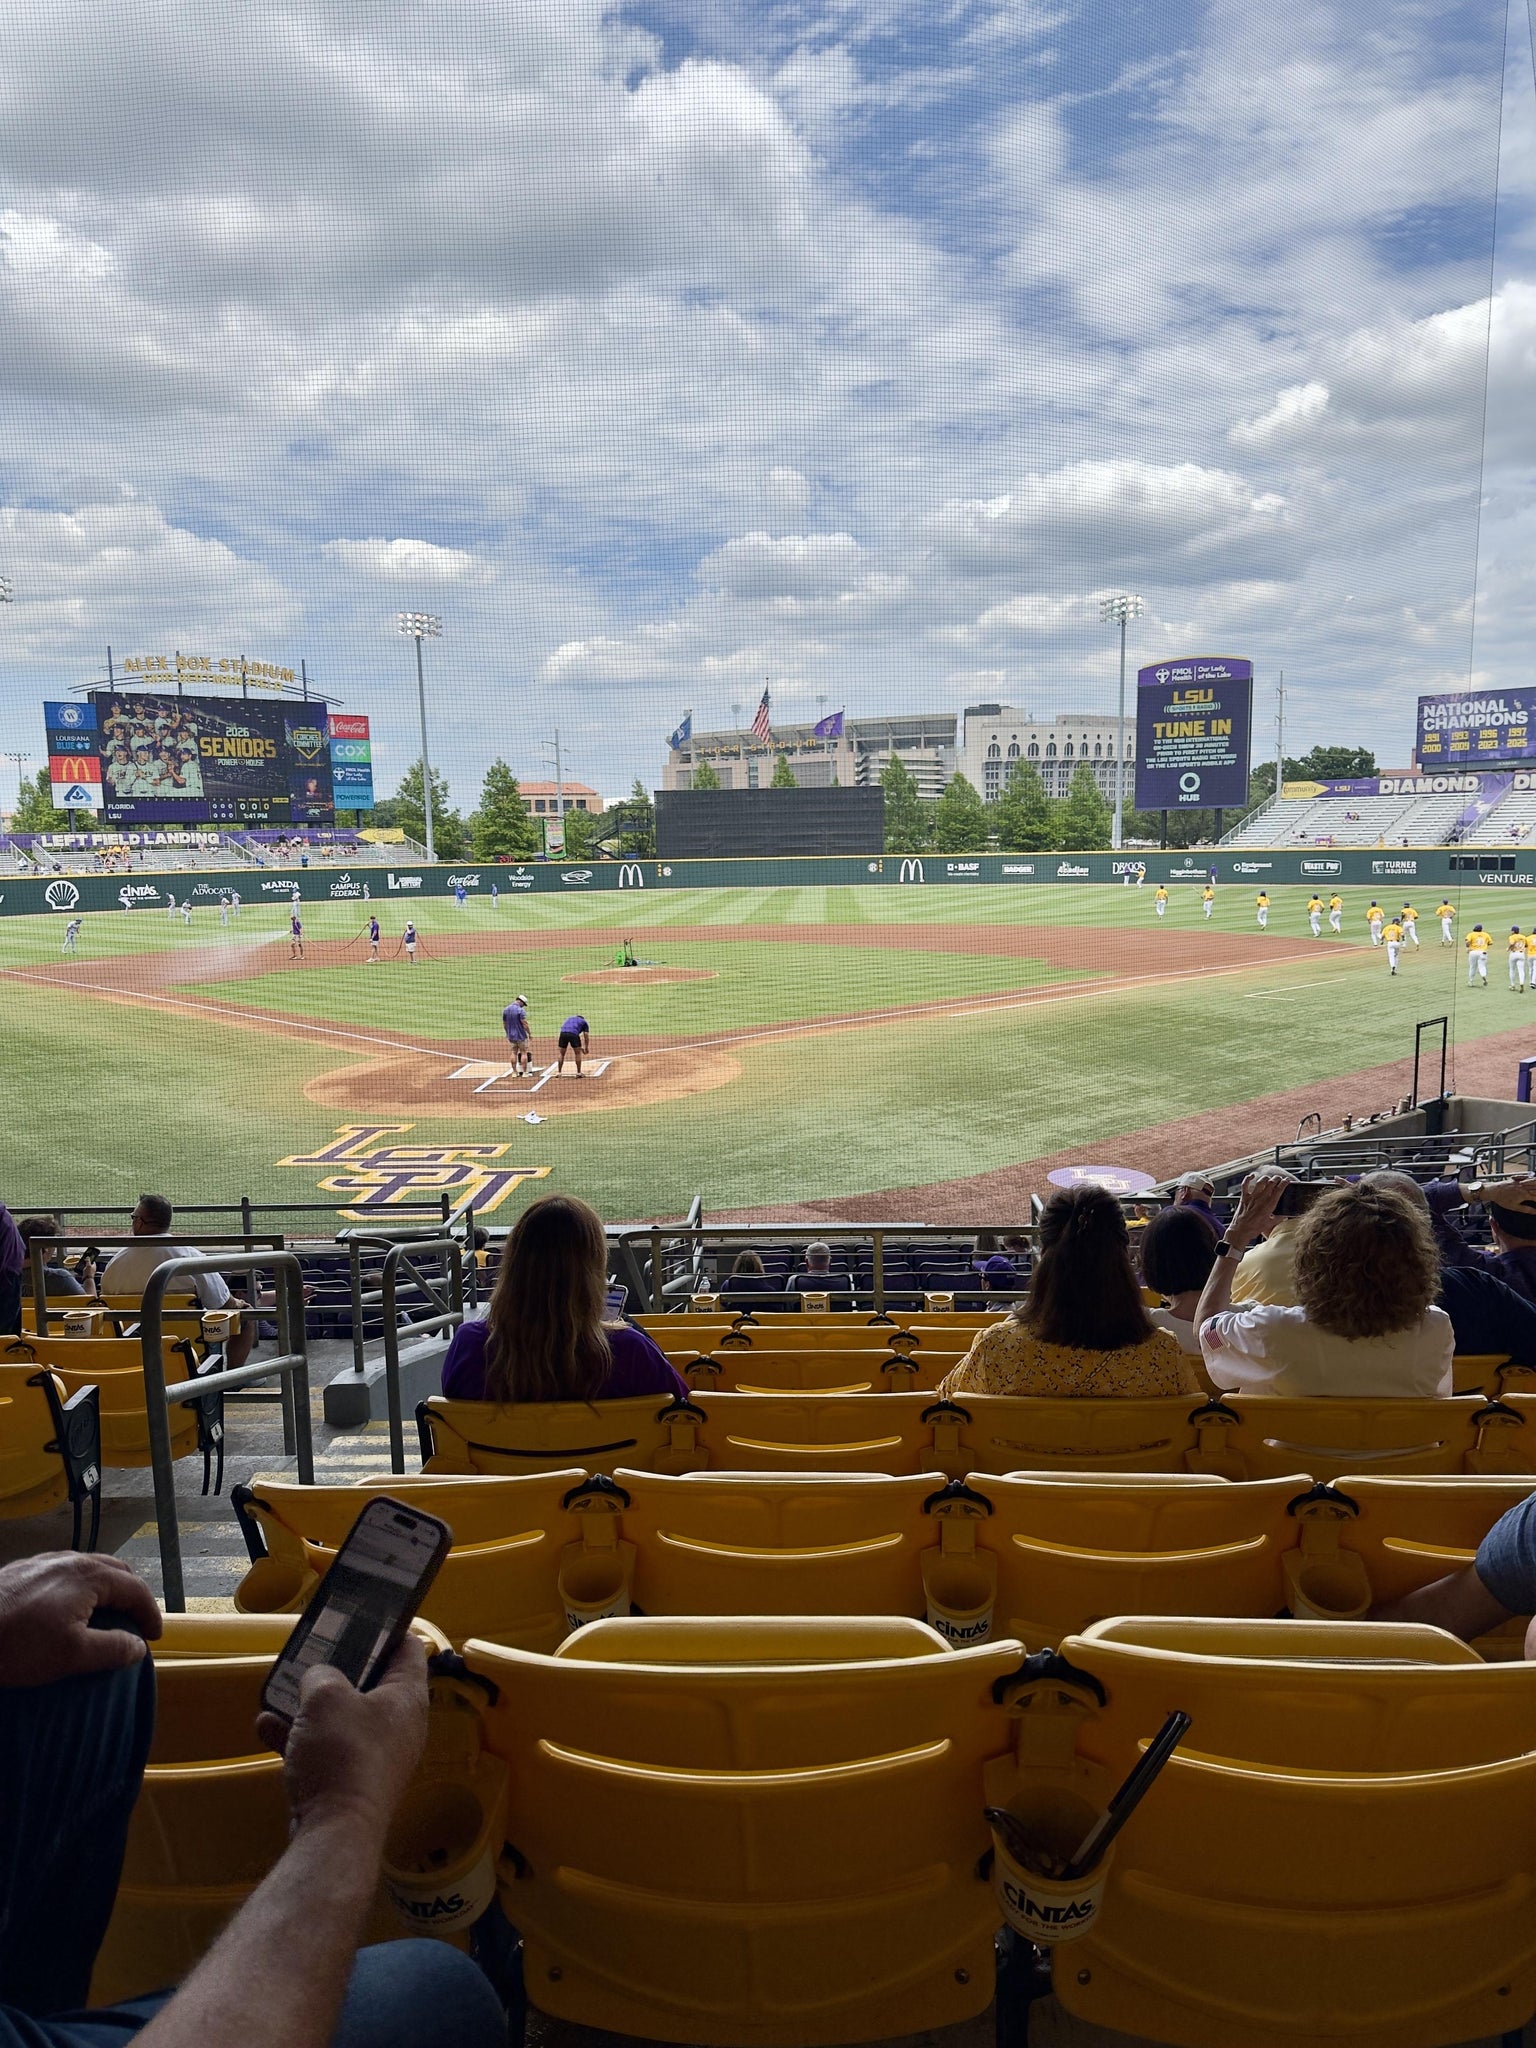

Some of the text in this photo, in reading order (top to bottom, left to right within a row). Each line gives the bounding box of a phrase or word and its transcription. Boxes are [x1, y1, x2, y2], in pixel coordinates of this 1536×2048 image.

[124, 656, 295, 682] ALEX BOX STADIUM
[1211, 665, 1226, 673] Lady
[1173, 688, 1214, 704] LSU
[1423, 699, 1509, 718] NATIONAL
[1423, 710, 1529, 731] CHAMPIONS
[226, 727, 249, 737] 2026
[1152, 718, 1232, 738] TUNE IN
[1424, 726, 1528, 743] 1991 1993 1996 1997
[56, 742, 75, 750] BLUE
[200, 737, 276, 758] SENIORS
[335, 745, 366, 756] COX
[700, 744, 739, 755] TIGER
[1422, 737, 1529, 754] 2000 2009 2023 2025
[1334, 785, 1351, 793] LSU
[1379, 775, 1480, 795] DIAMOND
[1178, 793, 1200, 801] HUB
[41, 832, 220, 847] LEFT FIELD LANDING
[958, 863, 979, 871] BASF
[447, 874, 481, 887] Coca-Cola
[1479, 874, 1533, 883] VENTURE
[192, 887, 234, 896] ADVOCATE
[261, 880, 299, 891] MANDA
[330, 882, 360, 891] CAMPUS
[330, 889, 360, 897] FEDERAL
[214, 1426, 220, 1436] 4
[88, 1470, 95, 1483] 5
[935, 1620, 988, 1638] CINTAS
[1003, 1881, 1093, 1923] CINTAS
